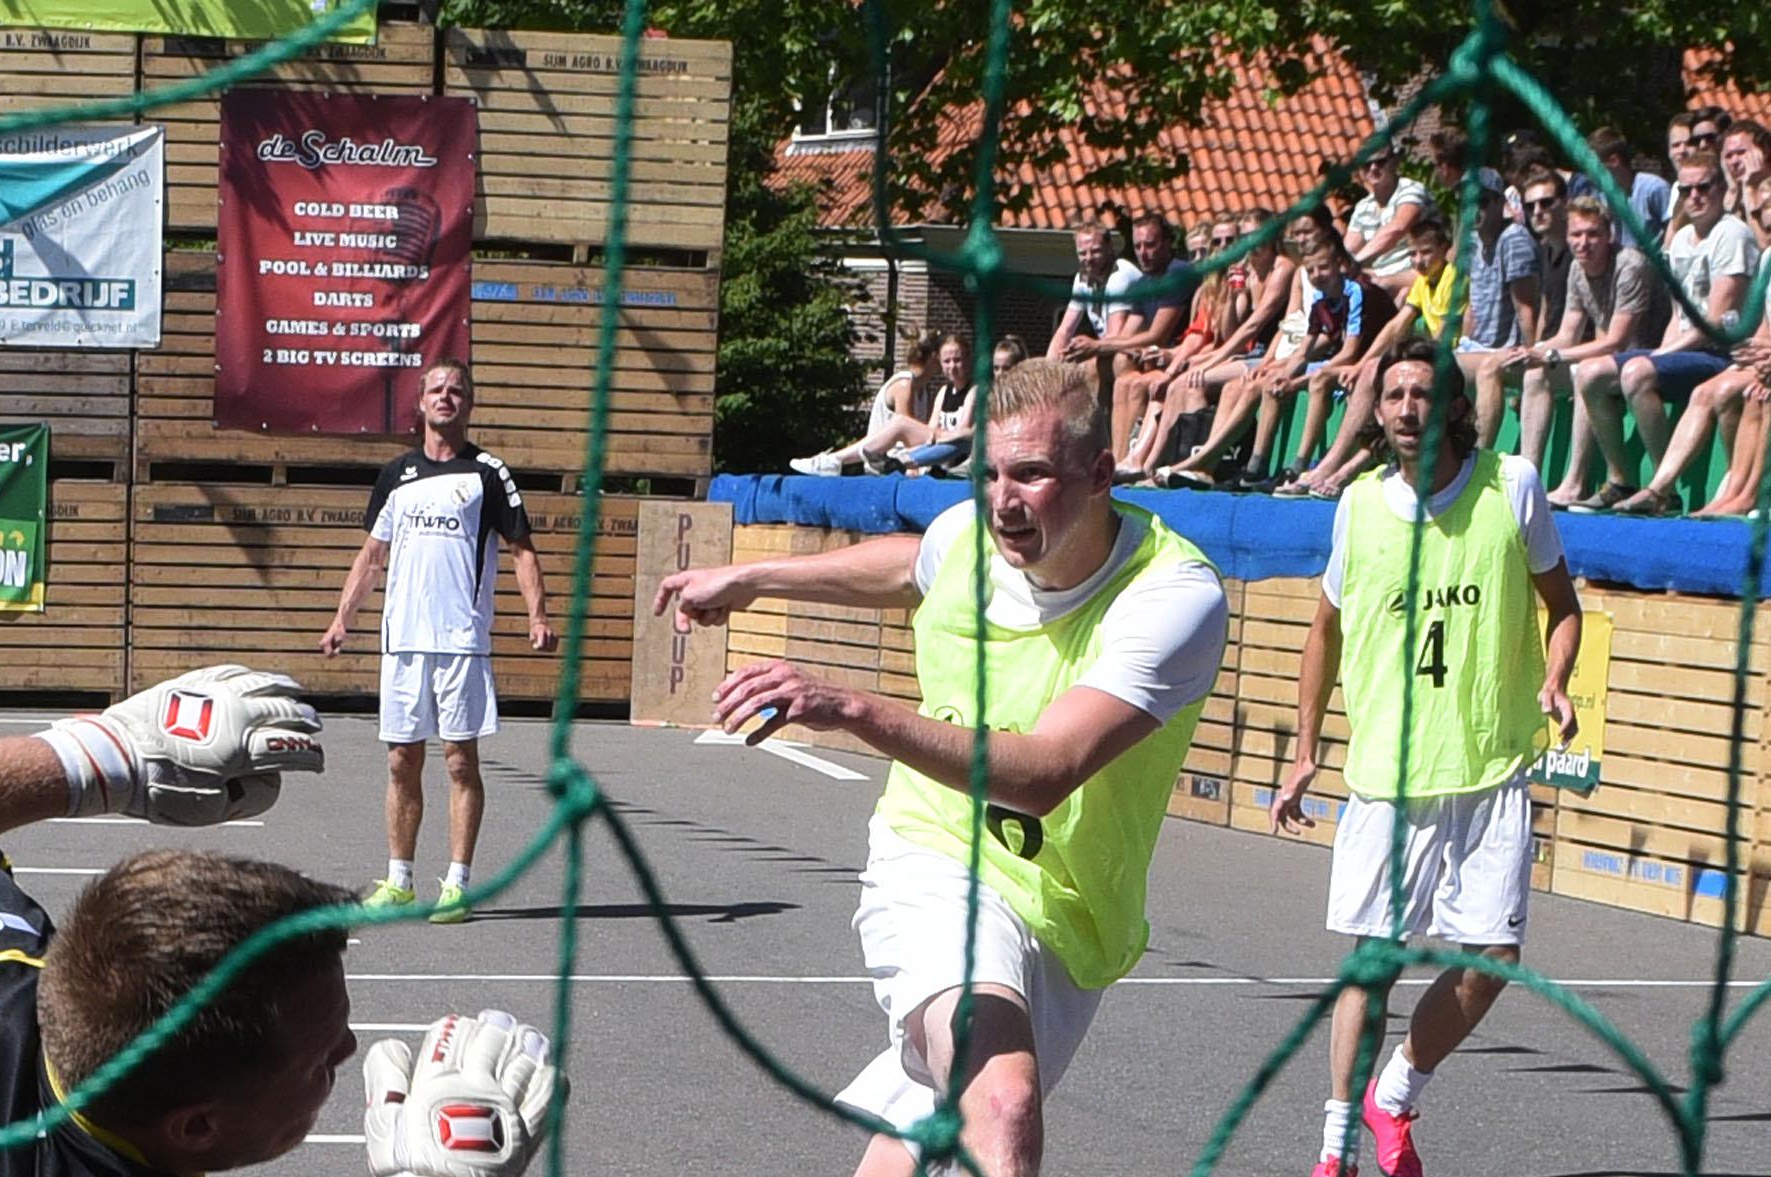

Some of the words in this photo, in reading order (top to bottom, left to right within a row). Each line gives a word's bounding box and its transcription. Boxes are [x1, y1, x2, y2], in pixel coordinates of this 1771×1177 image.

[31, 35, 91, 49] ZWAAGDIJK
[572, 55, 601, 70] AGRO
[295, 130, 438, 168] Schalm
[86, 166, 152, 206] behang
[294, 202, 345, 217] COLD
[348, 204, 399, 219] BEER
[293, 231, 335, 246] LIVE
[339, 233, 397, 248] MUSIC
[259, 260, 311, 275] POOL
[314, 262, 328, 276] &
[332, 262, 429, 279] BILLIARDS
[313, 291, 374, 307] DARTS
[265, 320, 329, 336] GAMES
[332, 321, 346, 336] &
[350, 322, 421, 338] SPORTS
[262, 349, 274, 363] 2
[276, 350, 310, 365] BIG
[314, 350, 337, 366] TV
[340, 351, 422, 367] SCREENS
[261, 508, 292, 522] AGRO
[670, 513, 693, 695] PUUP
[1422, 584, 1481, 611] JAKO
[1415, 619, 1449, 689] 4
[1546, 748, 1590, 780] paard
